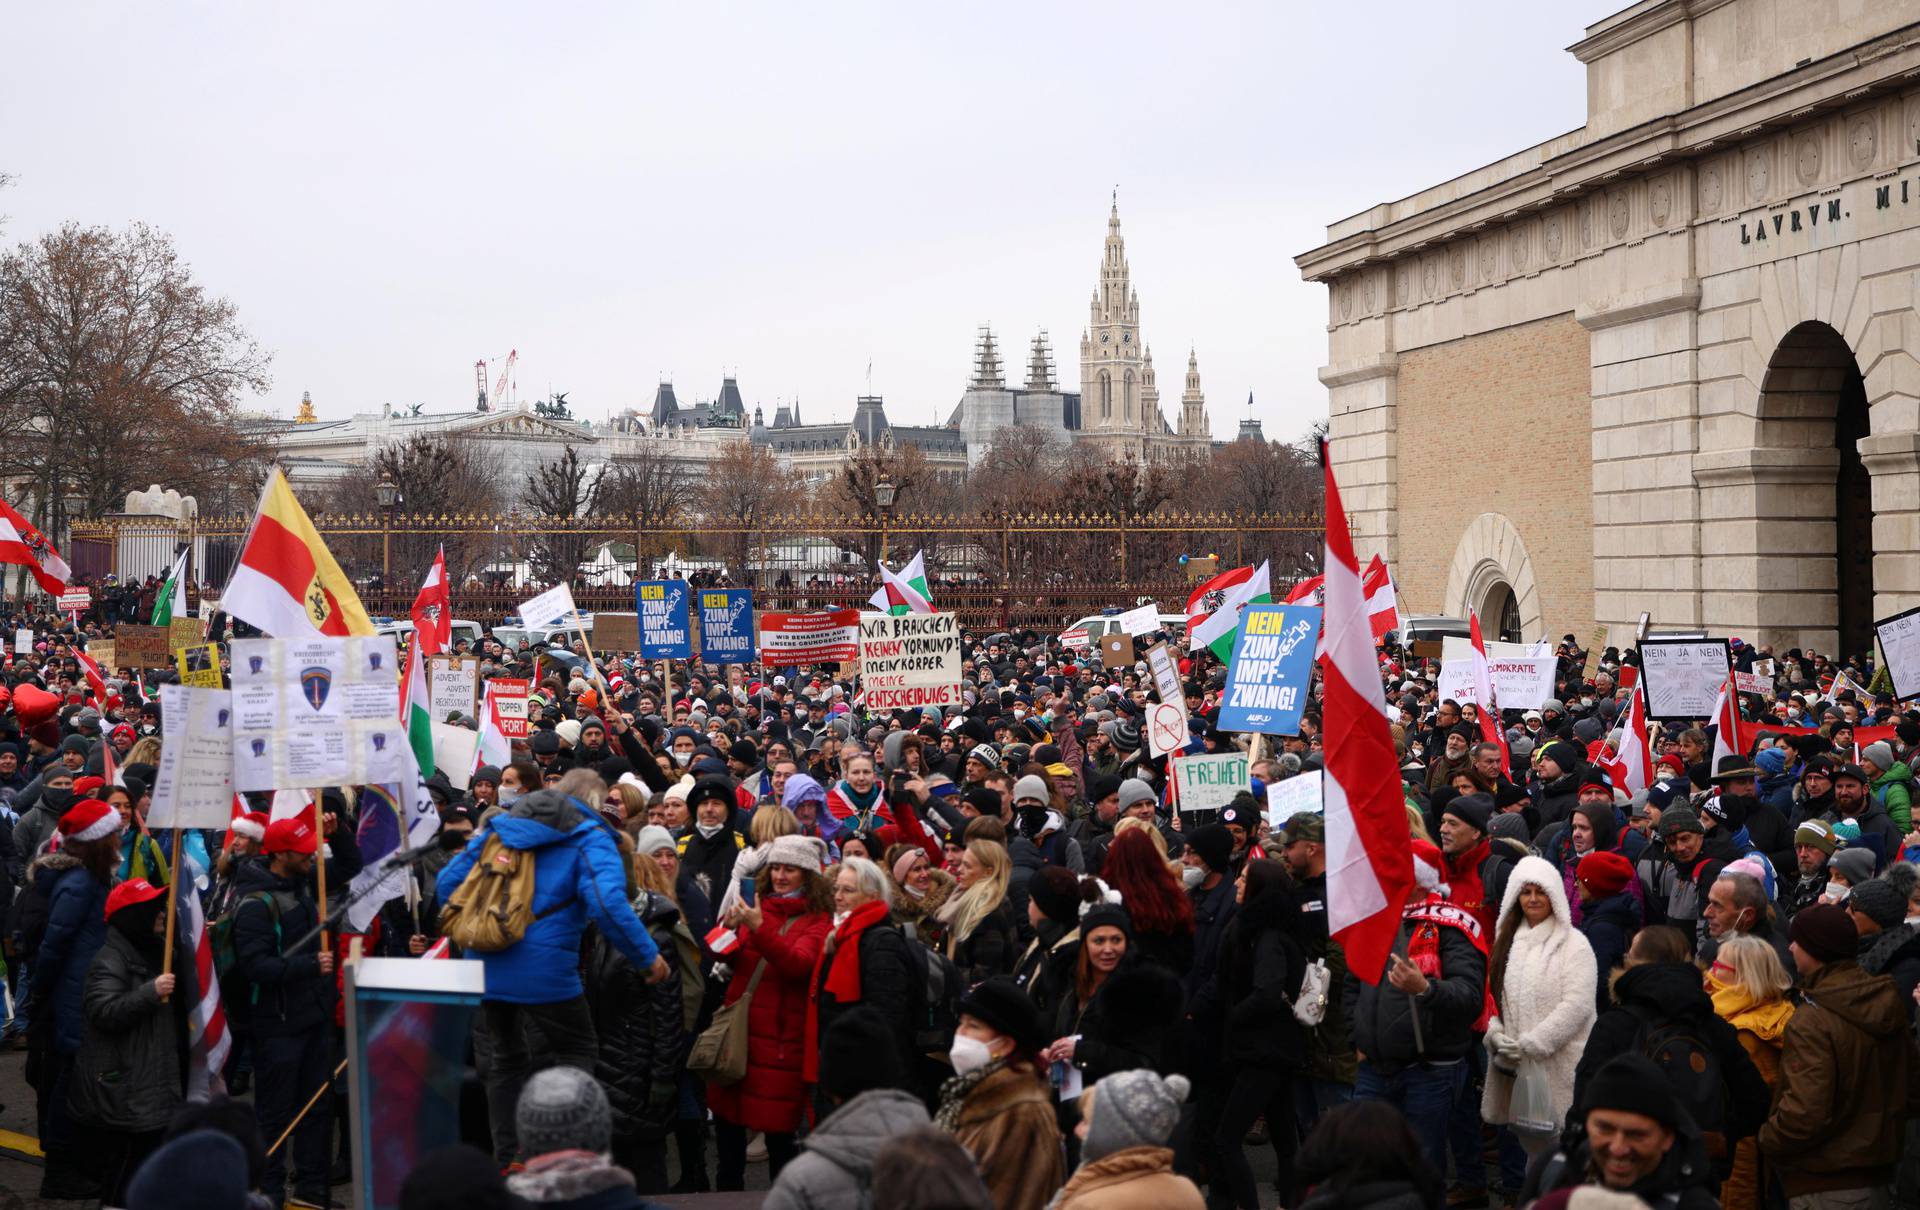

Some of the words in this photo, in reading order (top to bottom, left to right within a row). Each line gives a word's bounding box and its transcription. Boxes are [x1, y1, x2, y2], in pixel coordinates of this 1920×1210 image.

[1876, 176, 1920, 210] MI
[641, 585, 664, 600] NEIN
[642, 600, 665, 615] ZUM
[703, 594, 728, 608] NEIN
[643, 615, 674, 630] IMPF-
[704, 608, 729, 622] ZUM
[705, 622, 738, 637] IMPF-
[862, 619, 888, 638] WIR
[893, 615, 957, 639] BRAUCHEN
[1245, 611, 1284, 635] NEIN
[644, 630, 685, 645] ZWANG!
[706, 636, 749, 651] ZWANG!
[792, 632, 830, 640] BEHARREN
[798, 636, 850, 647] GRUNDRECHTE
[864, 640, 902, 659] KEINEN
[901, 637, 960, 655] VORMUND!
[1239, 635, 1280, 660] ZUM
[1644, 648, 1667, 658] NEIN
[1677, 648, 1689, 657] JA
[1700, 647, 1723, 657] NEIN
[866, 659, 901, 673] MEIN
[901, 655, 944, 672] KÖRPER
[1234, 659, 1285, 684] IMPF-
[868, 674, 905, 687] MEINE
[867, 685, 949, 708] ENTSCHEIDUNG
[1229, 683, 1298, 711] ZWANG!
[497, 703, 522, 712] TOPPEN
[1186, 760, 1249, 786] FREIHEIT
